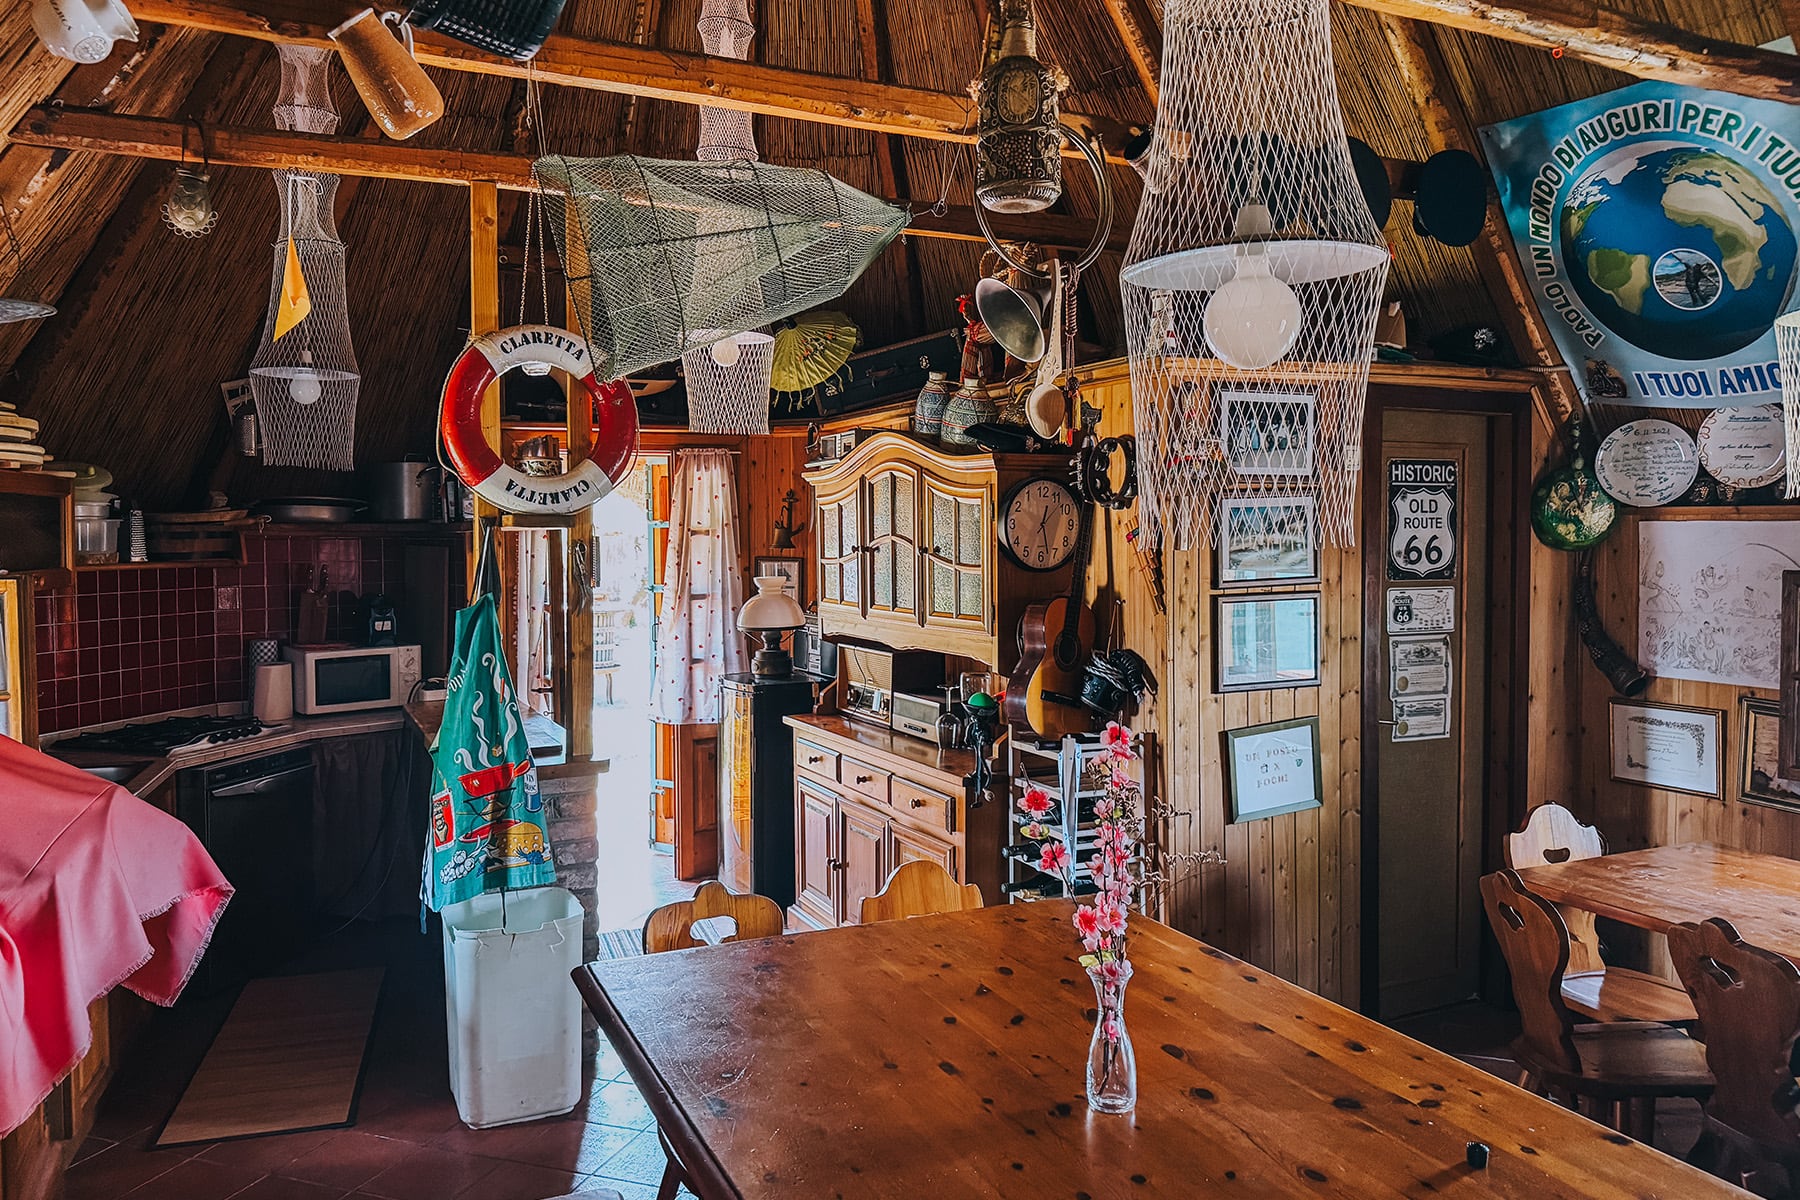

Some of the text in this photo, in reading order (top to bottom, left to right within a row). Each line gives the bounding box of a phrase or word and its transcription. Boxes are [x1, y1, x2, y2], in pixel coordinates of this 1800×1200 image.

[1529, 99, 1800, 350] PAOLO UN MONDO DI AUGURI PER I TUO
[500, 331, 586, 361] CLARETTA
[1633, 362, 1784, 398] I TUOI AMIC
[1391, 463, 1455, 483] HISTORIC
[504, 478, 590, 505] CLARETTA
[1025, 490, 1030, 502] 1
[1037, 486, 1050, 498] 12
[1052, 492, 1061, 504] 11
[1014, 501, 1021, 513] 2
[1060, 503, 1071, 516] 10
[1408, 498, 1439, 515] OLD
[1009, 518, 1016, 530] 3
[1068, 519, 1074, 531] 9
[1403, 516, 1443, 529] ROUTE
[1013, 535, 1020, 547] 4
[1062, 536, 1069, 548] 8
[1023, 546, 1030, 558] 5
[1052, 547, 1059, 559] 7
[1406, 534, 1443, 565] 66
[1038, 550, 1045, 563] 6
[1396, 611, 1409, 622] 66
